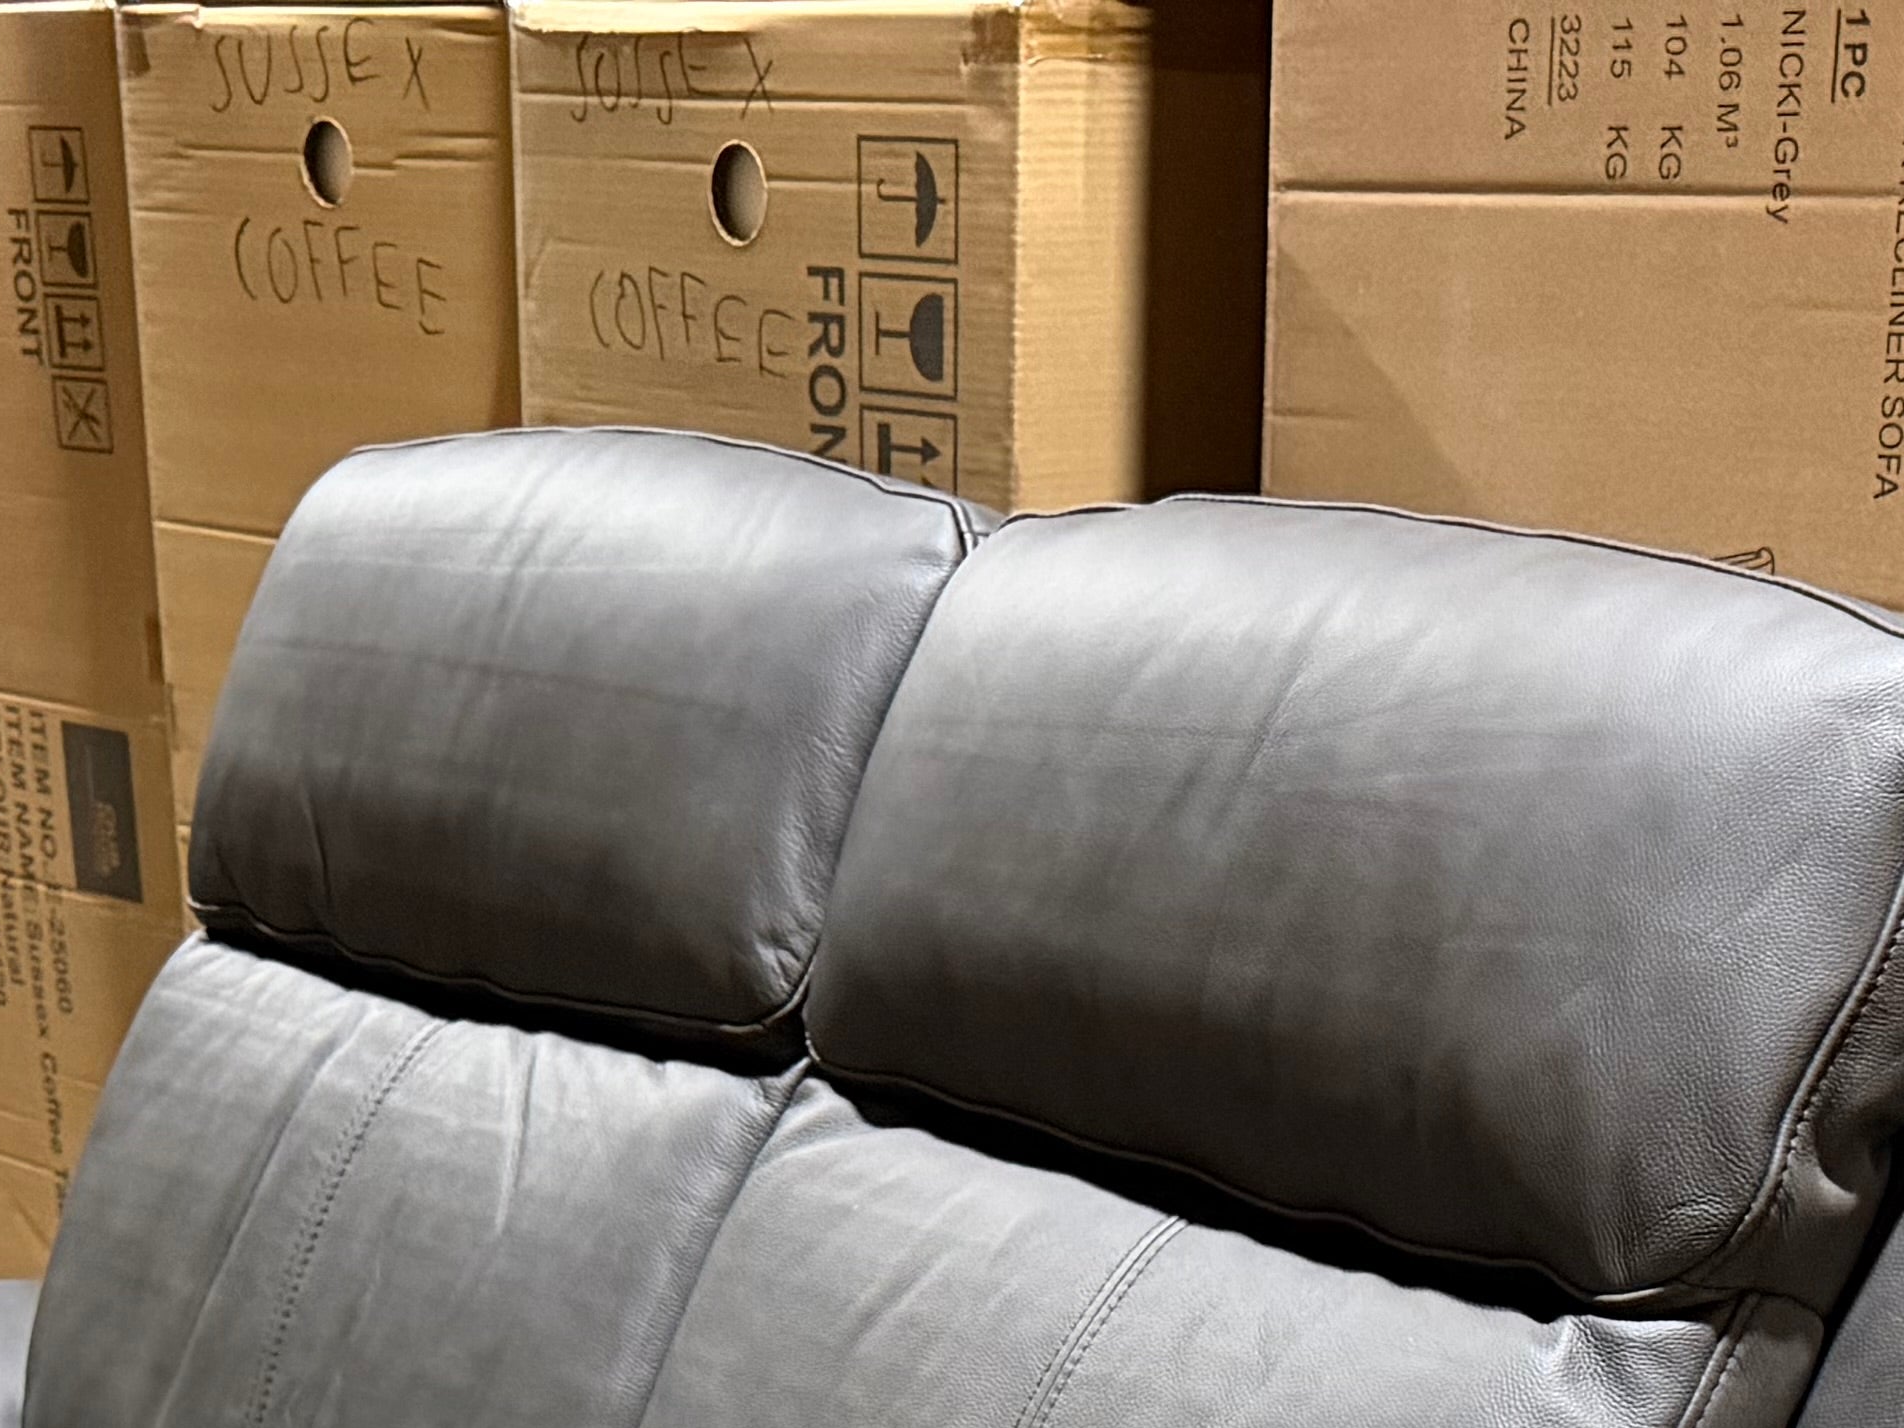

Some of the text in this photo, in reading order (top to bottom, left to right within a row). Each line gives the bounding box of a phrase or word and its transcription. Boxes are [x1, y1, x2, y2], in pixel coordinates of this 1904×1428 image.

[210, 17, 431, 112] SUSSEX
[1504, 18, 1531, 140] CHINA
[1557, 14, 1583, 102] 3223
[1604, 17, 1634, 181] 115 KG
[1658, 14, 1688, 181] 104 KG
[1717, 13, 1744, 92] 1.06
[1840, 9, 1871, 98] 1 PC
[1766, 9, 1807, 224] NICKI-Grey
[7, 208, 45, 366] FRONT
[234, 217, 446, 335] COFFEE
[589, 266, 793, 378] COFFEE
[807, 266, 848, 465] FRON
